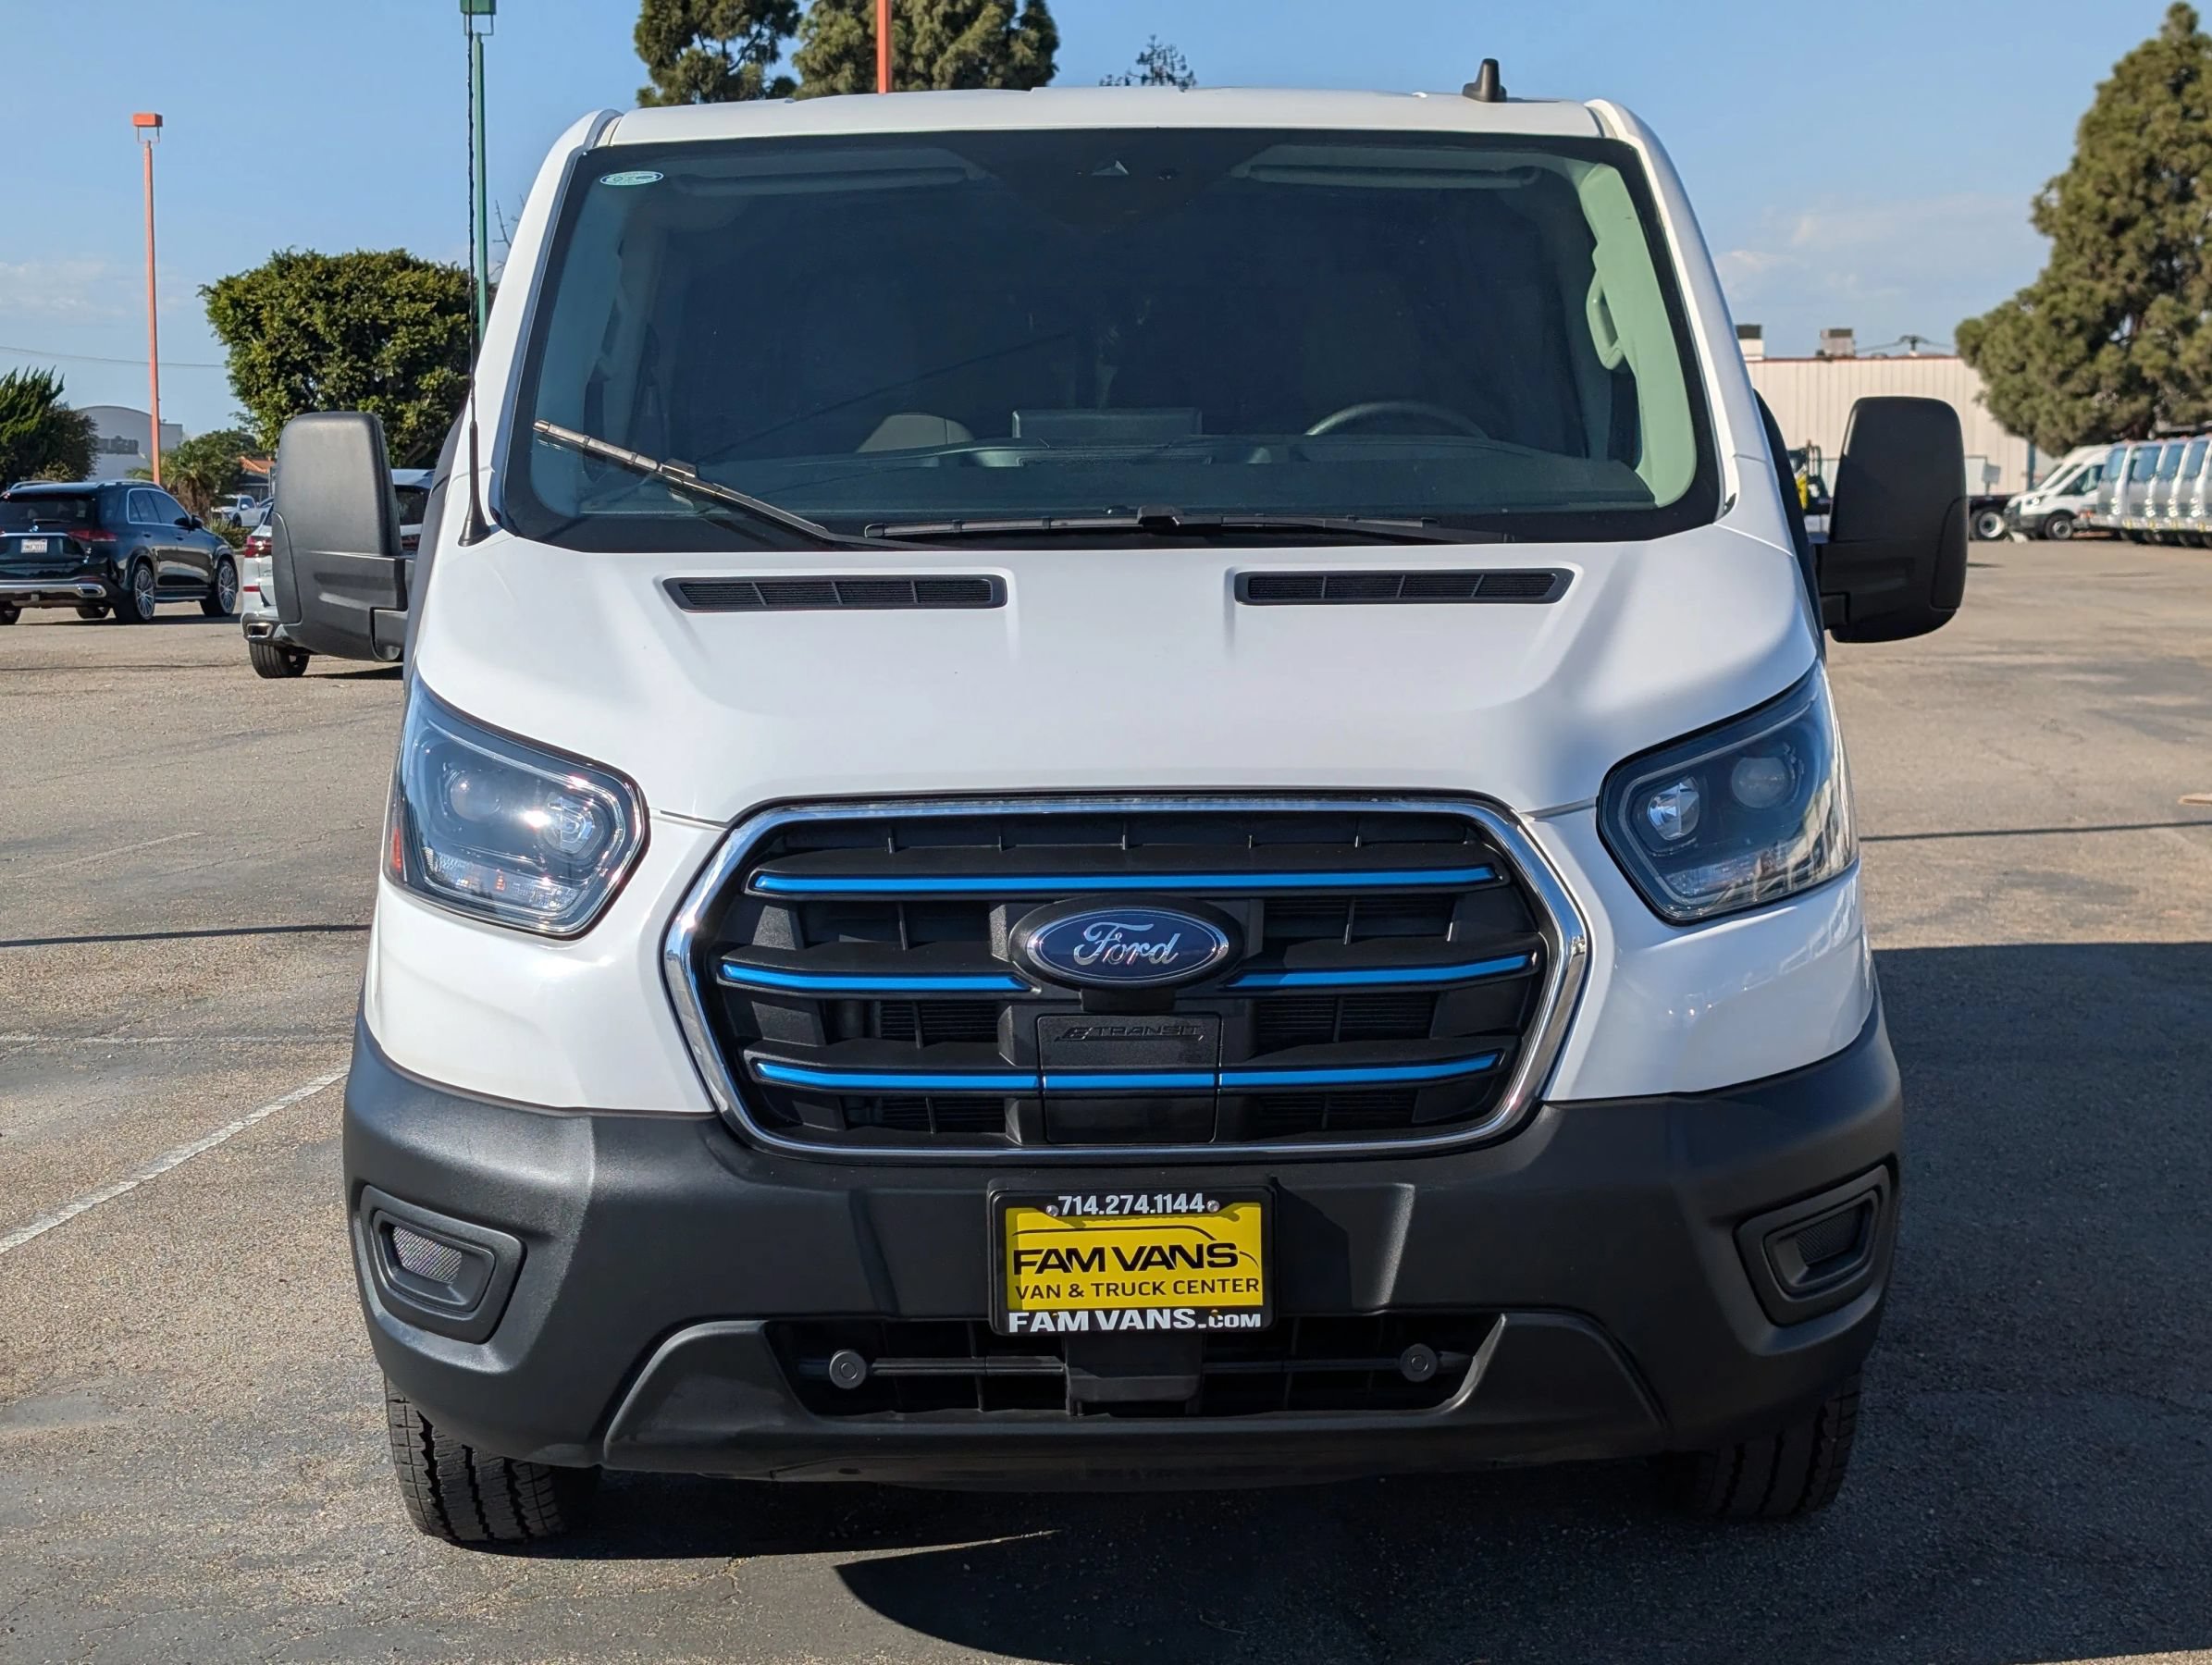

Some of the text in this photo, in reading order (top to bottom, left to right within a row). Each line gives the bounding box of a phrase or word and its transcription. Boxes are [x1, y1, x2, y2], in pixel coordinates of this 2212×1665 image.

[1073, 921, 1180, 966] Ford
[1057, 1193, 1205, 1215] 714.274.1144
[1013, 1242, 1239, 1276] FAM VANS
[1015, 1277, 1260, 1301] VAN & TRUCK CENTER
[1008, 1310, 1089, 1333] FAM
